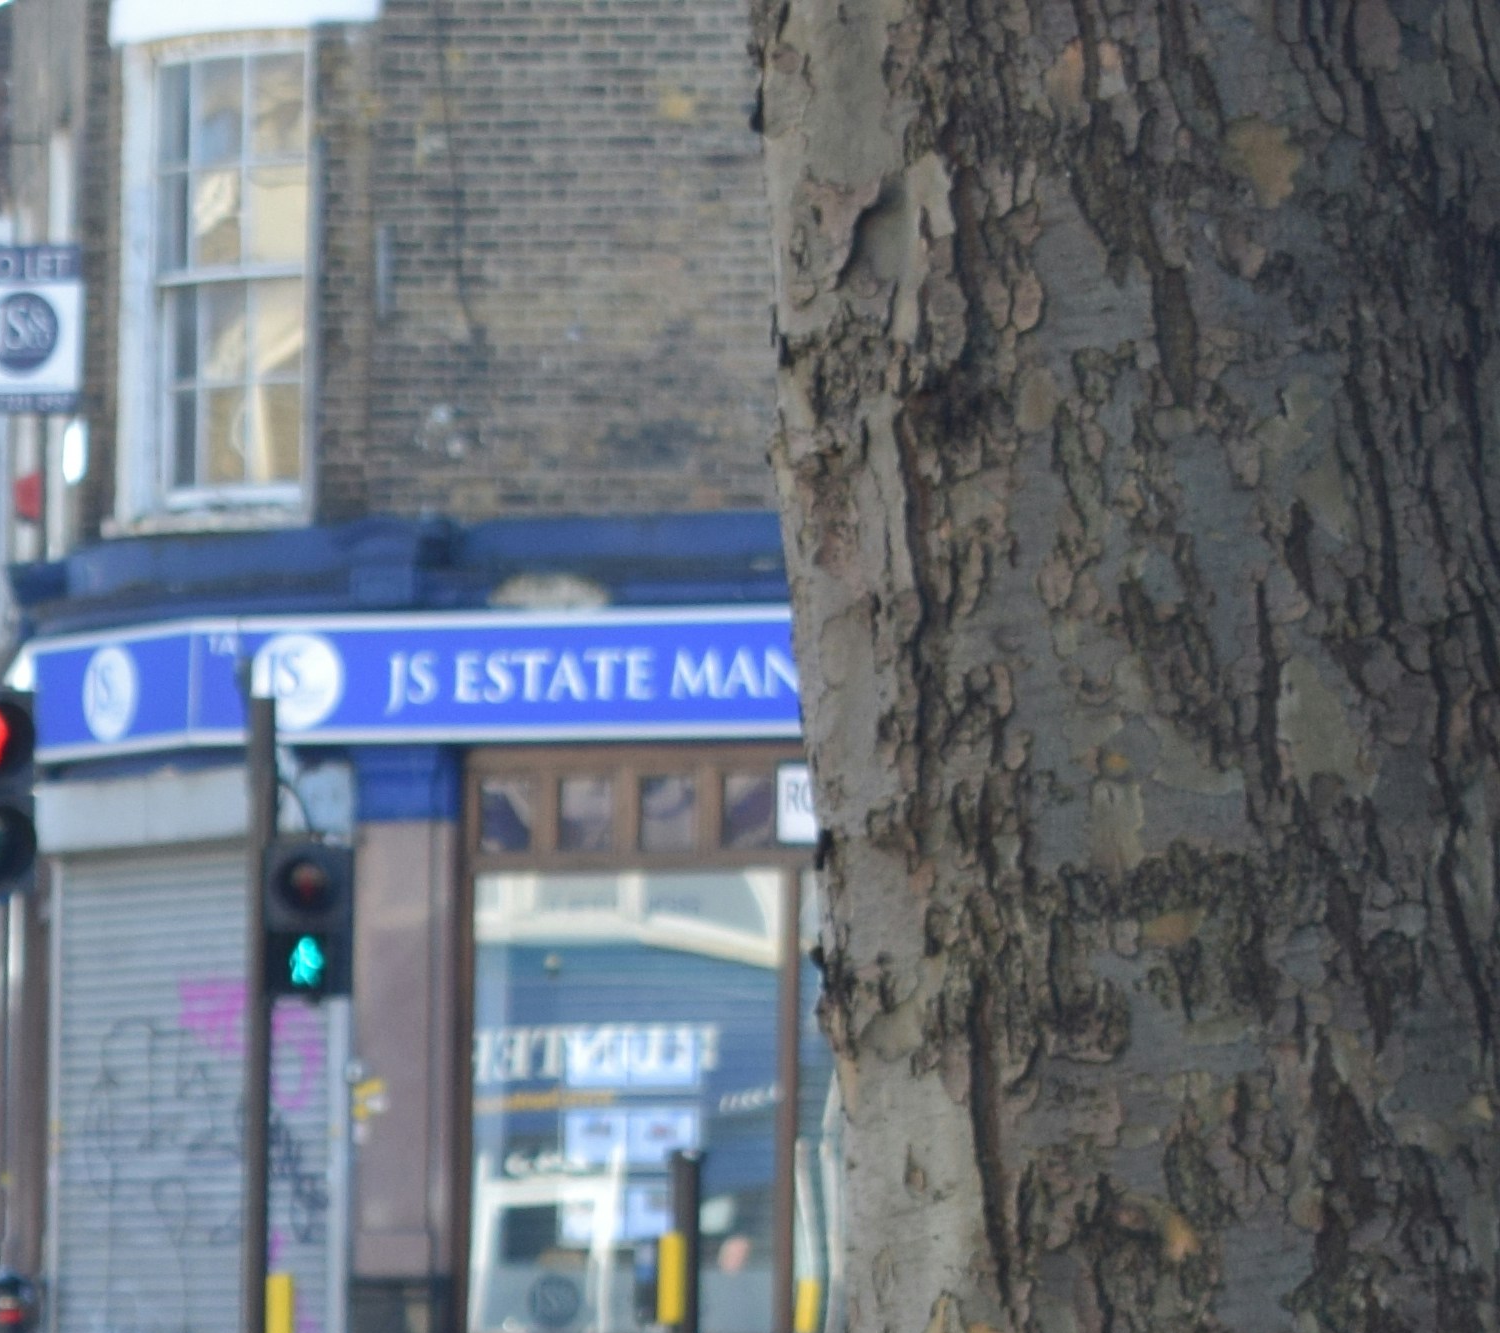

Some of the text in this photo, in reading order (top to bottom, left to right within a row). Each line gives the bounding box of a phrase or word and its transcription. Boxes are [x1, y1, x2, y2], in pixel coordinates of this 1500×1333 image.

[24, 252, 73, 280] LET
[384, 647, 440, 716] JS
[452, 646, 656, 703] ESTATE
